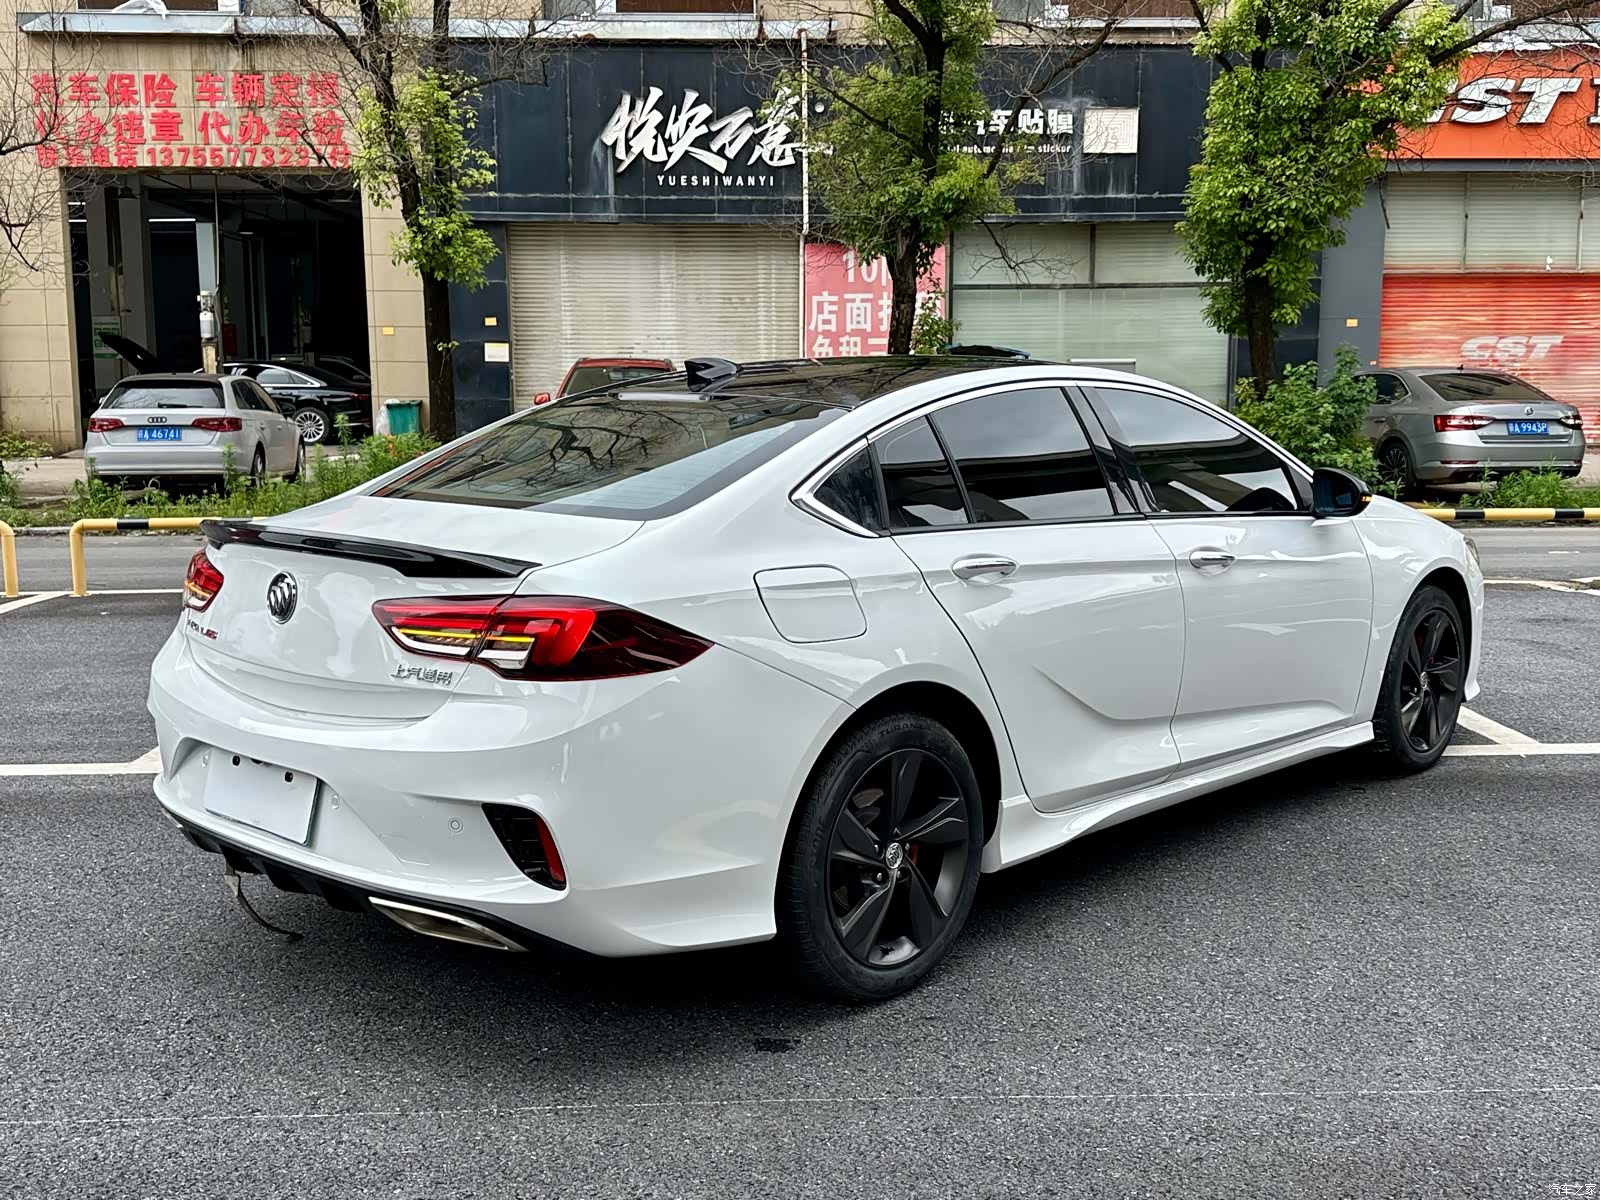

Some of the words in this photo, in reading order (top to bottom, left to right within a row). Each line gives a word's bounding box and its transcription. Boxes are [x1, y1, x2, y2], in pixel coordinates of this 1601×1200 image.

[32, 72, 178, 107] 汽车保险
[657, 175, 774, 187] YUESHIWANYI
[1461, 335, 1564, 361] CST
[390, 663, 454, 686] 上汽通用
